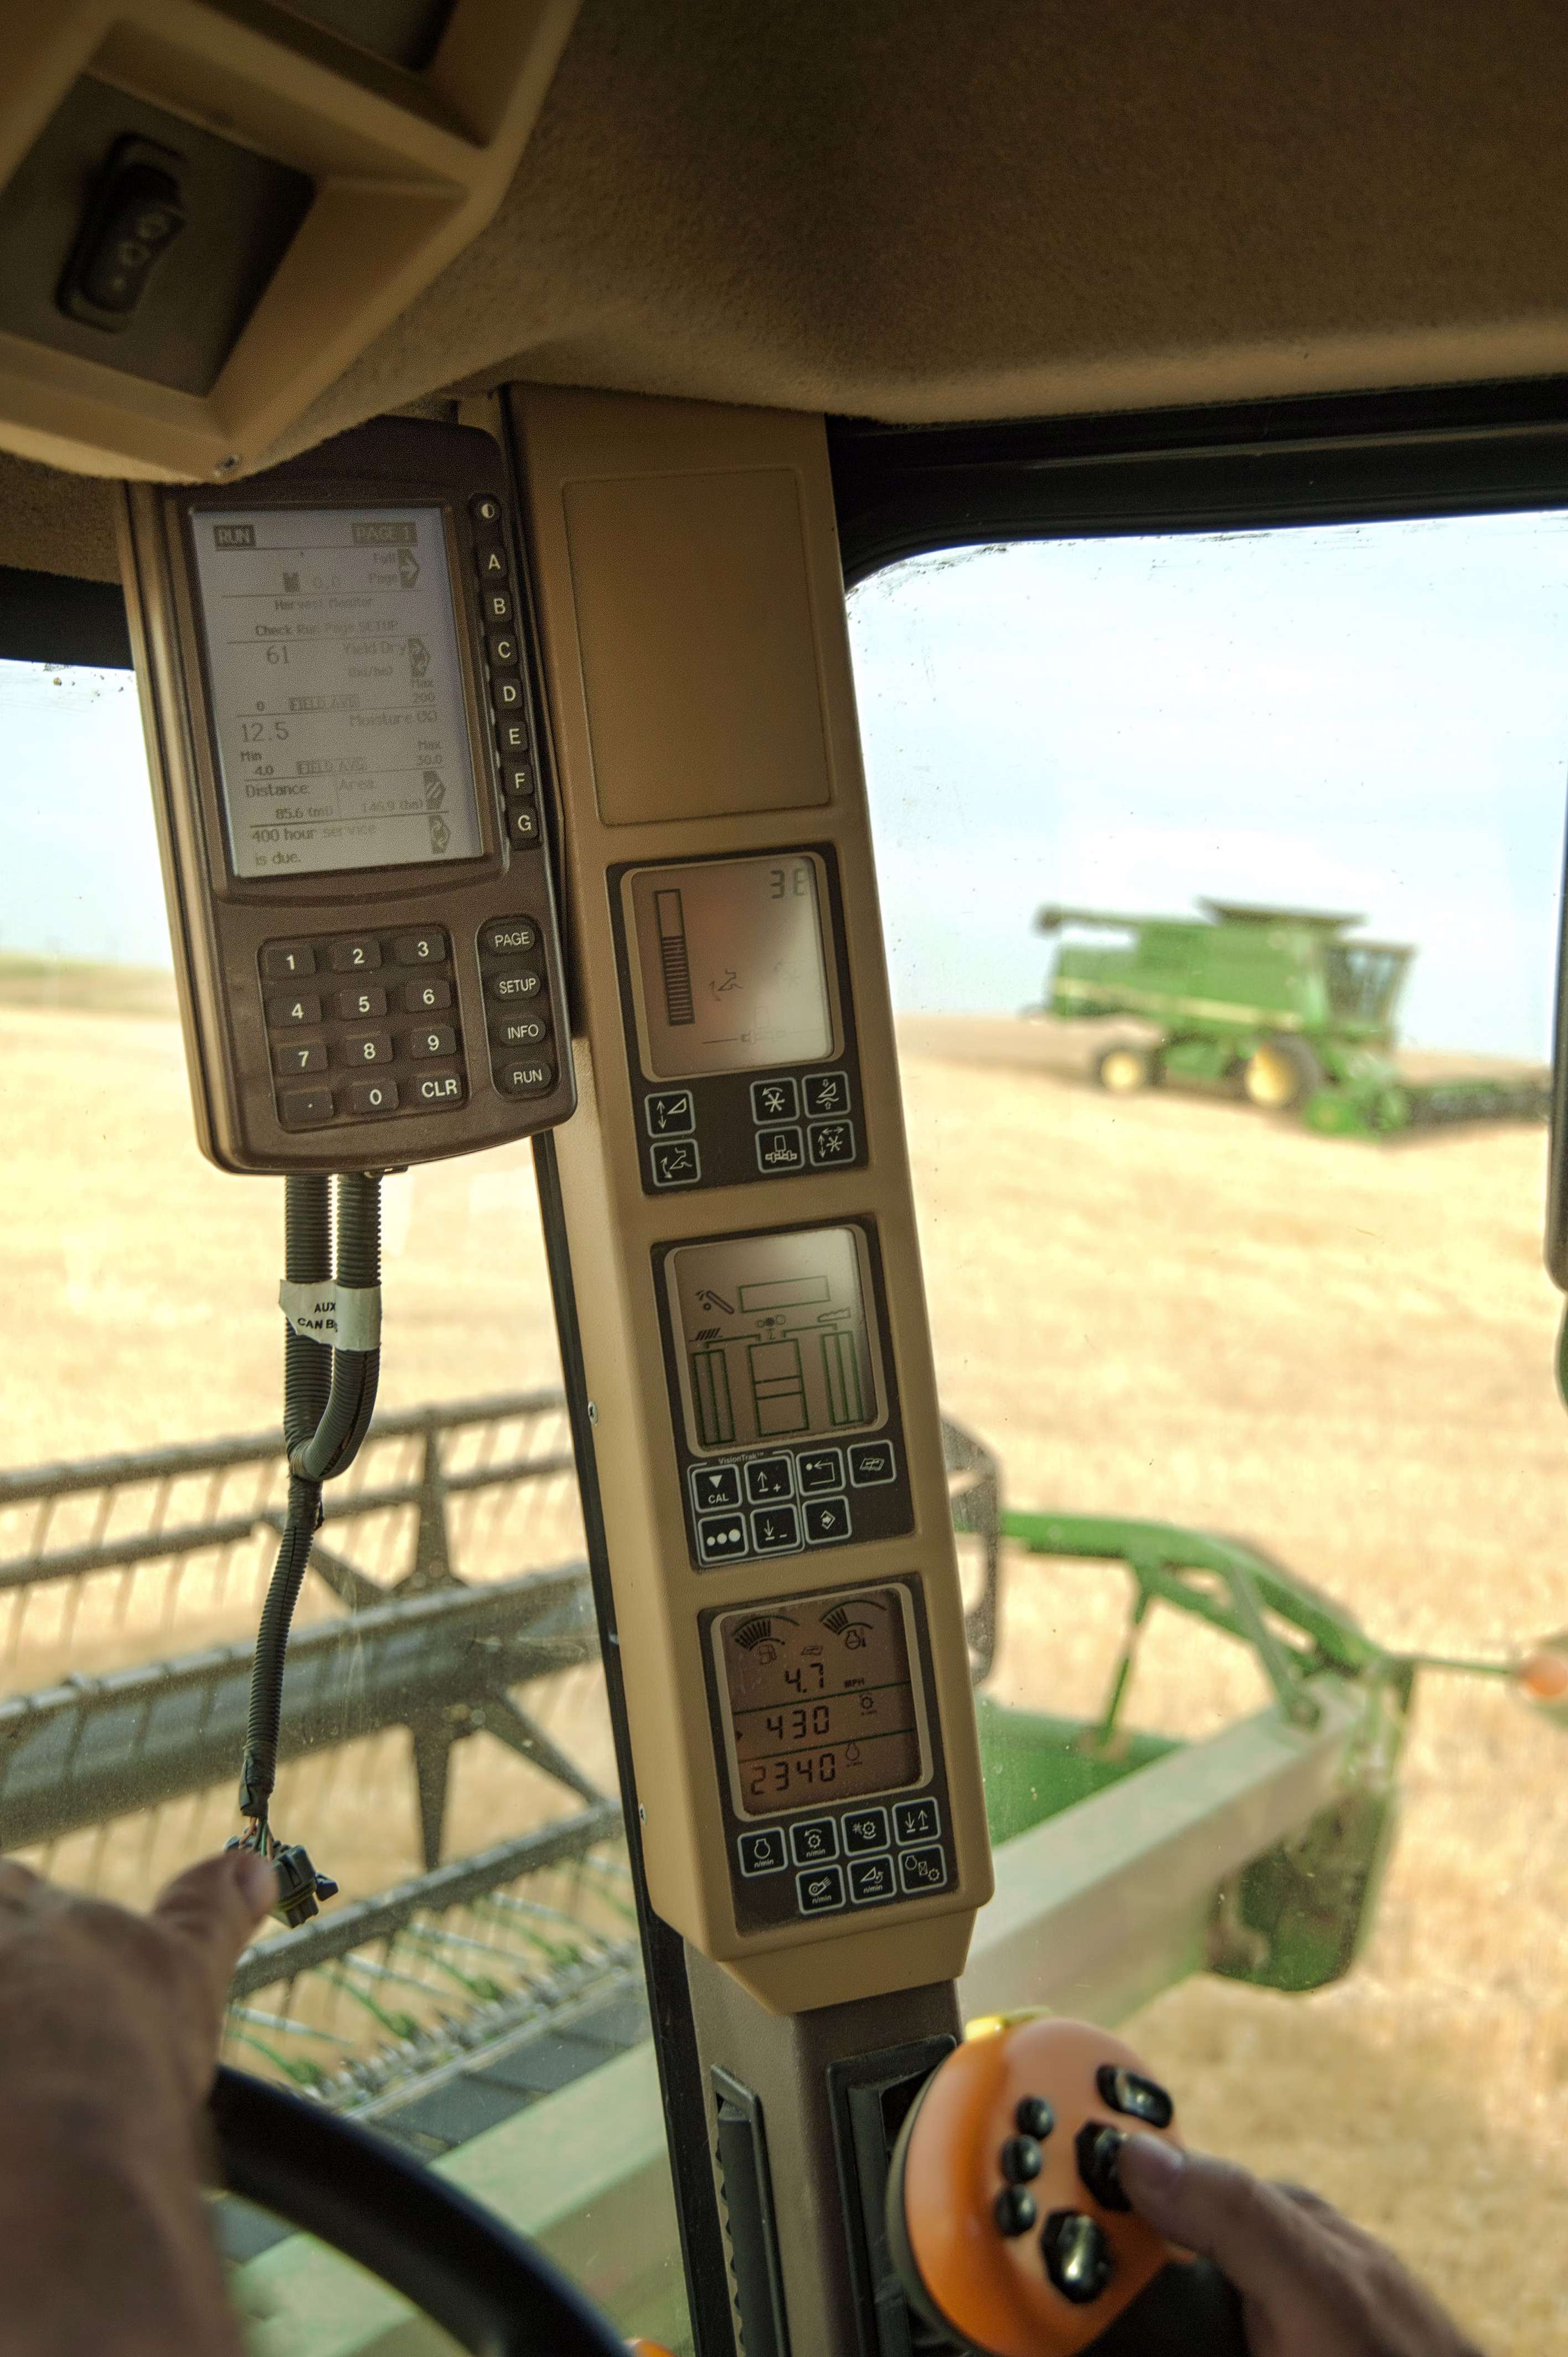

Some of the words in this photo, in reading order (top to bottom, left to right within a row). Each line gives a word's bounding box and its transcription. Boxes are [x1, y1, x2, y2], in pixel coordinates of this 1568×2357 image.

[488, 554, 501, 569] A
[493, 598, 506, 614] B
[255, 625, 292, 636] Check
[266, 645, 290, 665] 61
[498, 642, 510, 658] C
[503, 686, 515, 702] D
[241, 721, 289, 743] 12.5
[509, 729, 520, 744] E
[240, 751, 262, 762] Min
[515, 773, 525, 789] F
[245, 783, 308, 798] Distance
[275, 807, 304, 820] 85.6
[518, 815, 532, 831] G
[251, 829, 280, 844] 400
[283, 825, 317, 840] hour
[255, 853, 267, 866] is
[272, 851, 301, 864] due.
[495, 932, 530, 948] PAGE
[353, 949, 365, 964] 2
[417, 942, 429, 957] 3
[286, 955, 296, 970] 1
[499, 978, 536, 994] SETUP
[359, 996, 370, 1012] 5
[423, 989, 435, 1004] 6
[292, 1003, 303, 1018] 4
[508, 1023, 539, 1039] INFO
[427, 1036, 439, 1051] 9
[364, 1044, 375, 1059] 8
[298, 1052, 309, 1067] 7
[513, 1069, 542, 1085] RUN
[422, 1079, 457, 1098] CLR
[370, 1089, 382, 1105] 0
[314, 1302, 336, 1313] AUX
[297, 1318, 323, 1329] CAN
[709, 1493, 730, 1504] CAL
[785, 1663, 824, 1692] 4.7
[844, 1677, 865, 1689] MPH
[767, 1705, 829, 1739] 430
[751, 1753, 835, 1795] 2340
[806, 1849, 826, 1858] n/min
[754, 1859, 774, 1868] n/min
[863, 1884, 883, 1894] n/min
[812, 1895, 832, 1905] n/min
